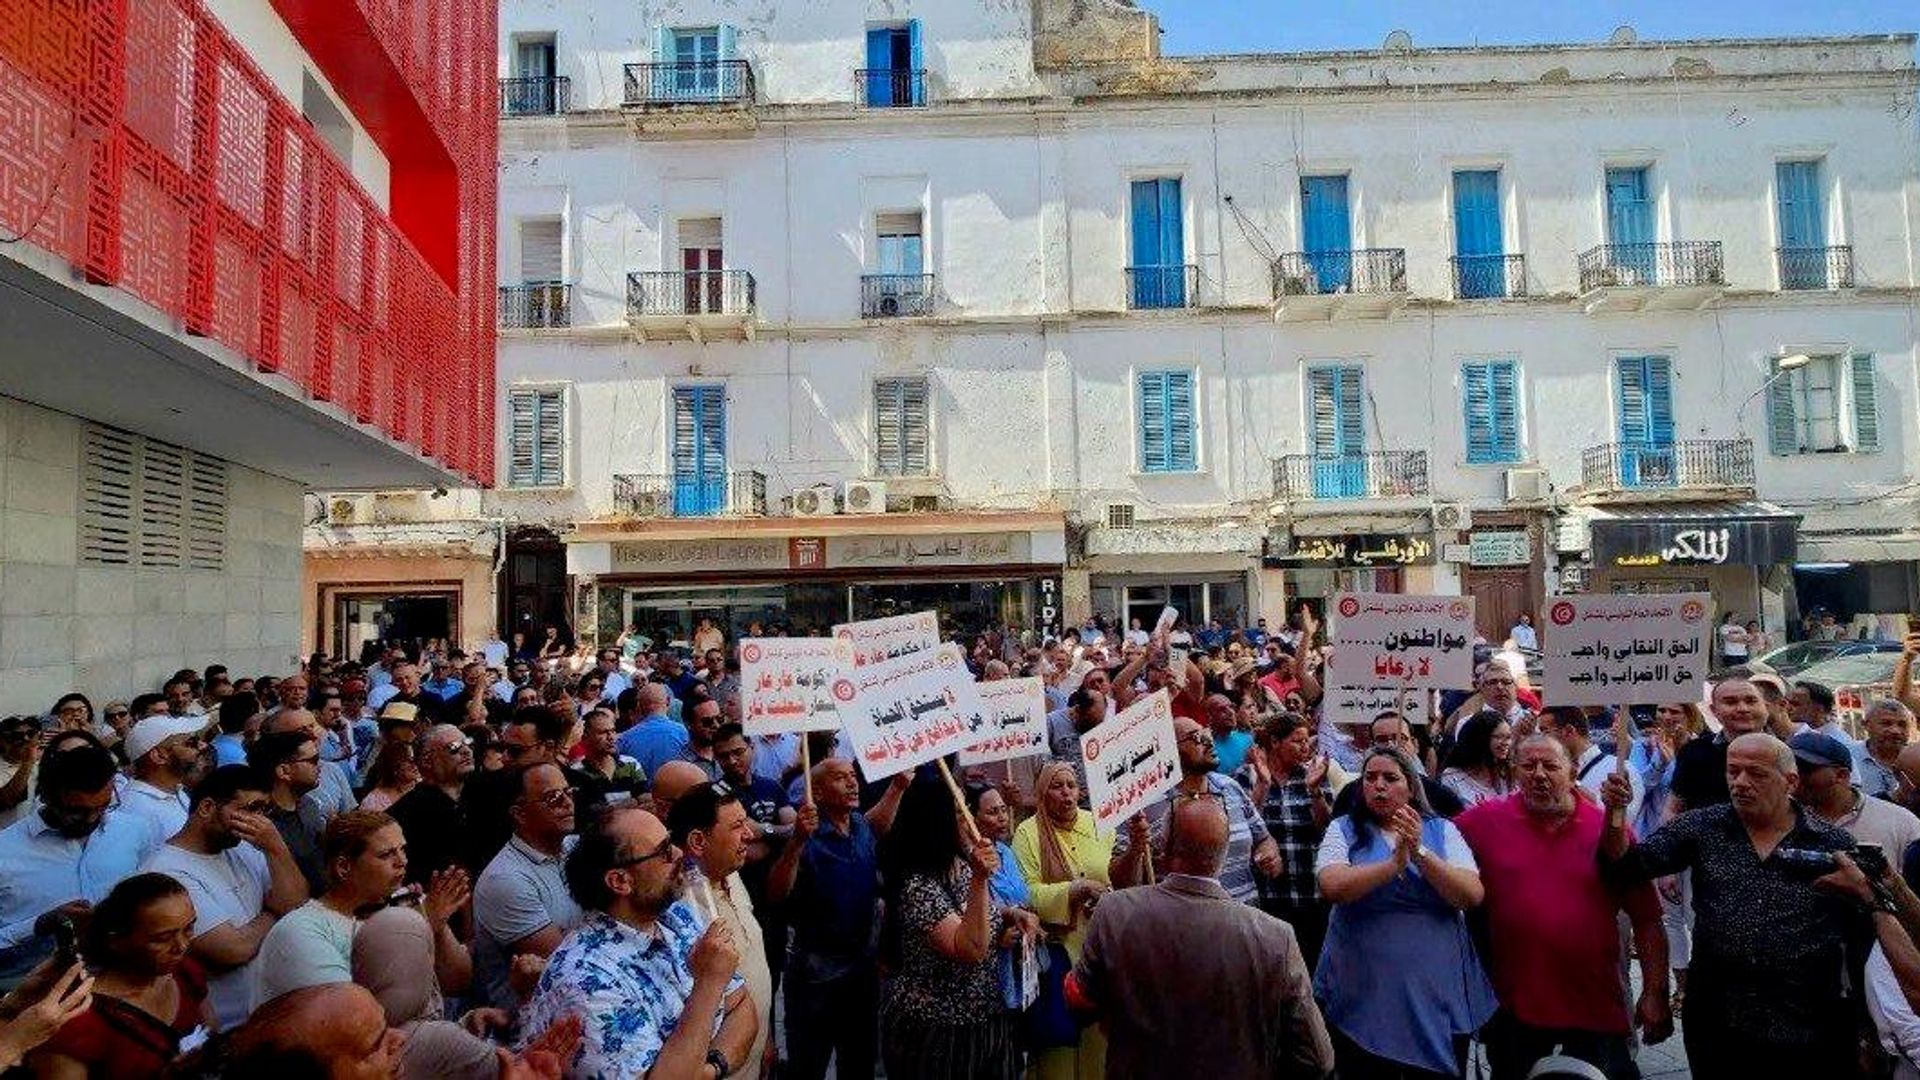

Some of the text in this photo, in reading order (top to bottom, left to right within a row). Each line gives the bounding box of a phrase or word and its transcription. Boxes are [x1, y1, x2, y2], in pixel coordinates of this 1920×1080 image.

[1614, 637, 1664, 663] النقابي
[1668, 637, 1699, 659] الحق
[1375, 655, 1415, 681] رعايا
[1569, 665, 1609, 686] واجب
[1673, 665, 1693, 685] حق
